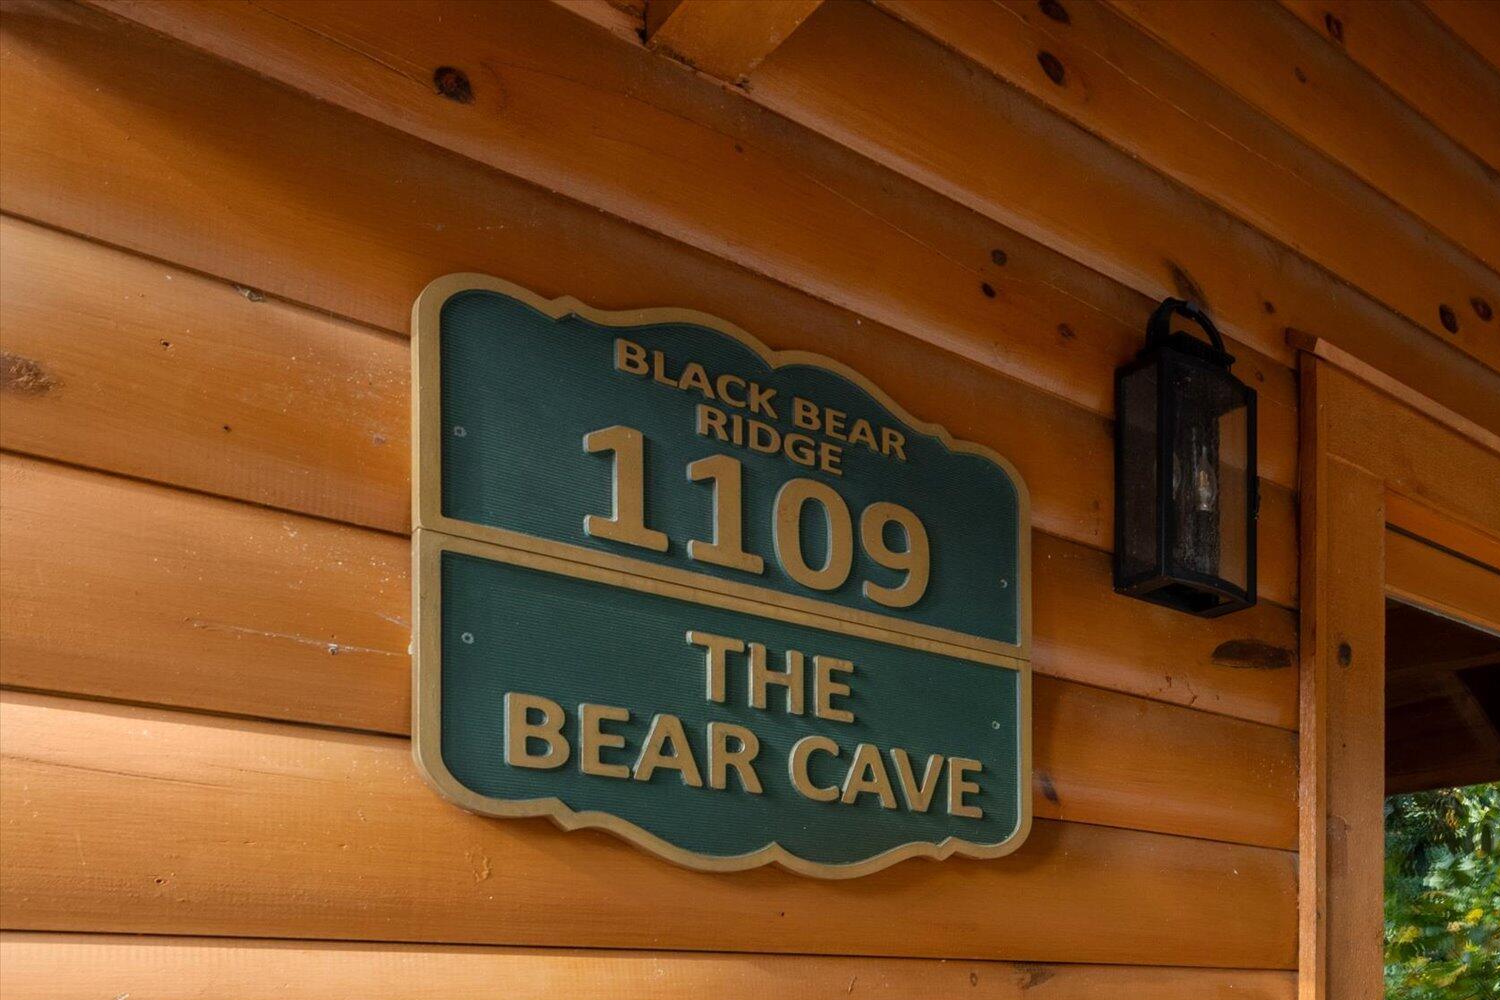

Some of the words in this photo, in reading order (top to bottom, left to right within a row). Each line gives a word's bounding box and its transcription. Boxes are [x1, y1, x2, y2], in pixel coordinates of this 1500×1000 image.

[614, 338, 778, 419] BLACK
[793, 396, 906, 460] BEAR
[696, 404, 843, 475] RIDGE
[583, 425, 931, 609] 1109
[686, 630, 855, 723] THE
[503, 692, 763, 794] BEAR
[788, 736, 983, 819] CAVE
